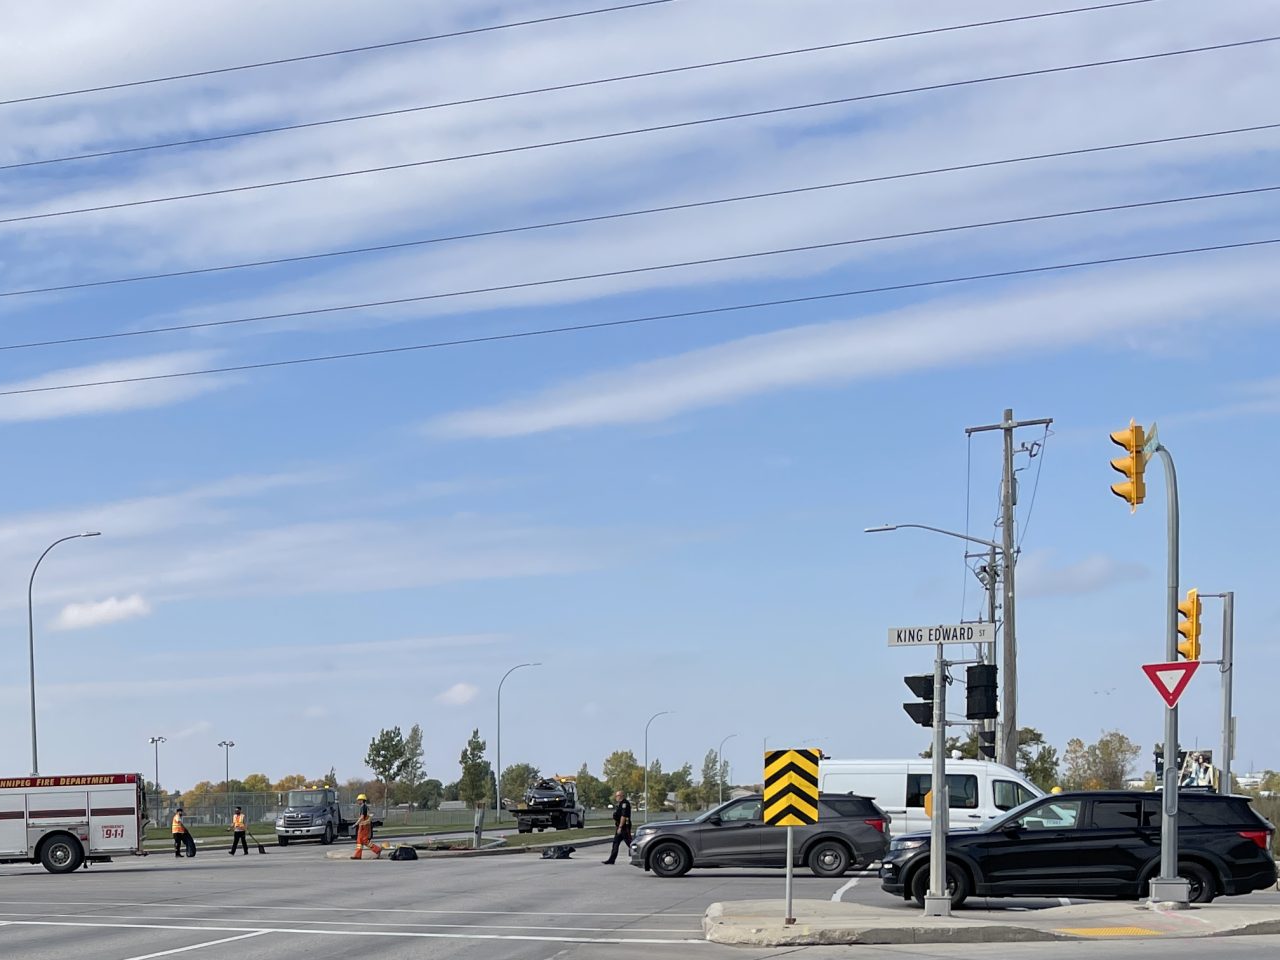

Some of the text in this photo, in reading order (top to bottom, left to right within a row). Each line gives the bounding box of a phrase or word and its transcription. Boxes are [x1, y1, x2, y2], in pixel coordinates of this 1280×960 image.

[896, 627, 986, 643] KING EDWARD ST
[36, 778, 55, 786] FIRE
[60, 776, 115, 785] DEPARTMENT
